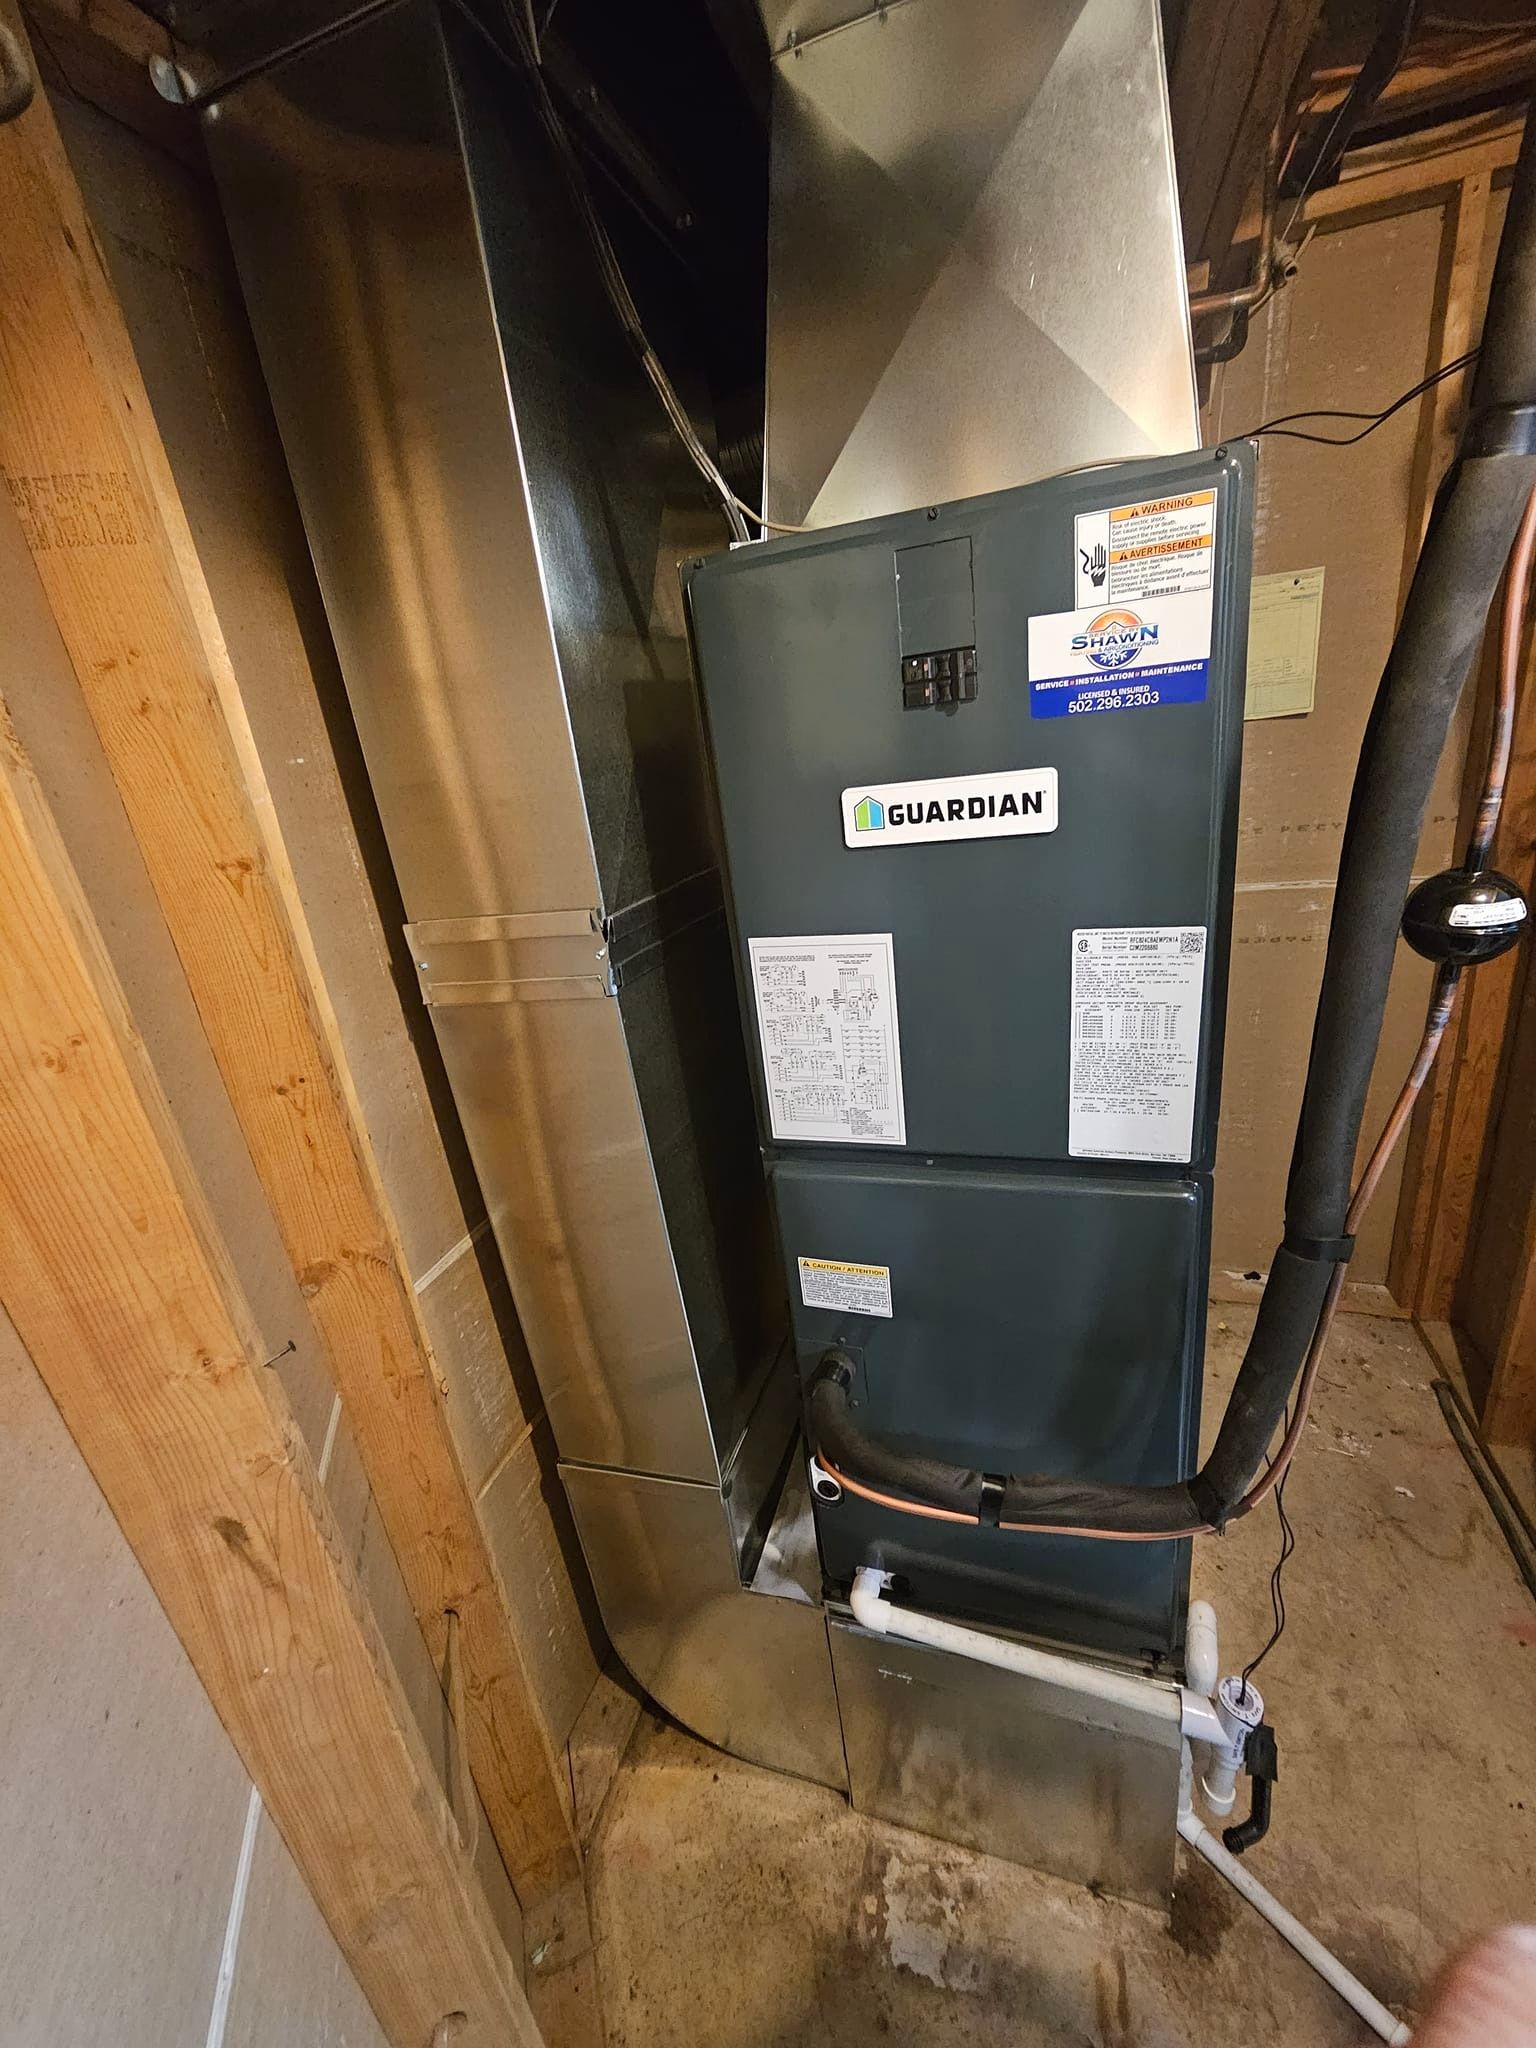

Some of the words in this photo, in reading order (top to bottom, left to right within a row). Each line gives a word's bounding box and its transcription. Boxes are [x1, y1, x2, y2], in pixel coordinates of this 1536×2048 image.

[1141, 497, 1193, 514] WARNING
[1129, 538, 1203, 558] AVERTISSEMENT
[1071, 625, 1159, 650] SHAWN
[1035, 679, 1069, 691] SERVICE
[1075, 671, 1135, 686] INSTALLATION
[1140, 662, 1204, 678] MAINTENANCE
[1068, 691, 1160, 714] 502.296.2303
[1077, 690, 1111, 700] LICENSED
[1111, 689, 1118, 697] &
[1118, 684, 1150, 695] INSURED
[888, 791, 1043, 826] GUARDIAN
[812, 1262, 842, 1272] CAUTION
[847, 1267, 885, 1276] ATTENTION
